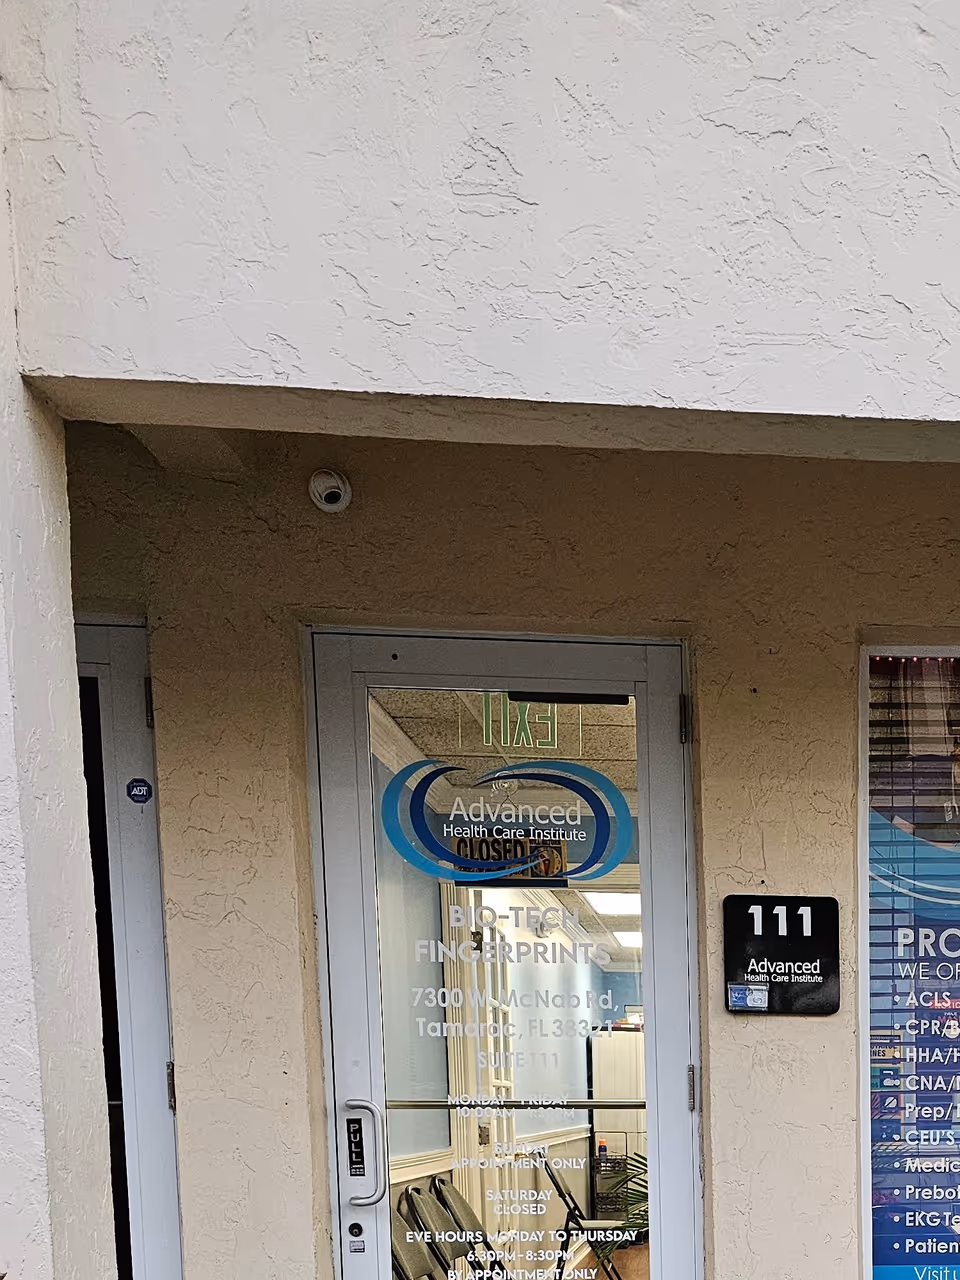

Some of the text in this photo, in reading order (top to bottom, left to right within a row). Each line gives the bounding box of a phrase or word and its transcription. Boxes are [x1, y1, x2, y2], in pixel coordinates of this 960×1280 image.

[449, 797, 581, 825] Advanced
[443, 824, 587, 841] Health Care Institute
[456, 838, 526, 861] CLOSED
[450, 905, 579, 928] BIO-TECH
[748, 905, 812, 937] 111
[415, 939, 612, 966] FINGERPRINTS
[748, 957, 821, 974] Advanced
[898, 962, 930, 980] WE
[744, 973, 824, 983] Health Care Institute
[411, 987, 463, 1008] 7300
[502, 989, 581, 1009] McNab
[905, 991, 952, 1008] ACLS
[528, 1019, 549, 1038] FL
[477, 1052, 525, 1069] SUITE
[447, 1094, 506, 1106] MONDAY
[905, 1103, 954, 1121] Prep/
[350, 1123, 362, 1162] PULL
[494, 1142, 550, 1154] SUNDAY
[452, 1158, 587, 1170] APPOINTMENT ONLY
[486, 1189, 553, 1201] SATURDAY
[494, 1203, 547, 1215] CLOSED
[905, 1211, 941, 1227] EKG
[406, 1230, 638, 1244] EVE HOURS MONDAY TO THURSDAY
[525, 1249, 574, 1262] 8:30PM
[466, 1268, 598, 1280] APPOINTMENT ONLY
